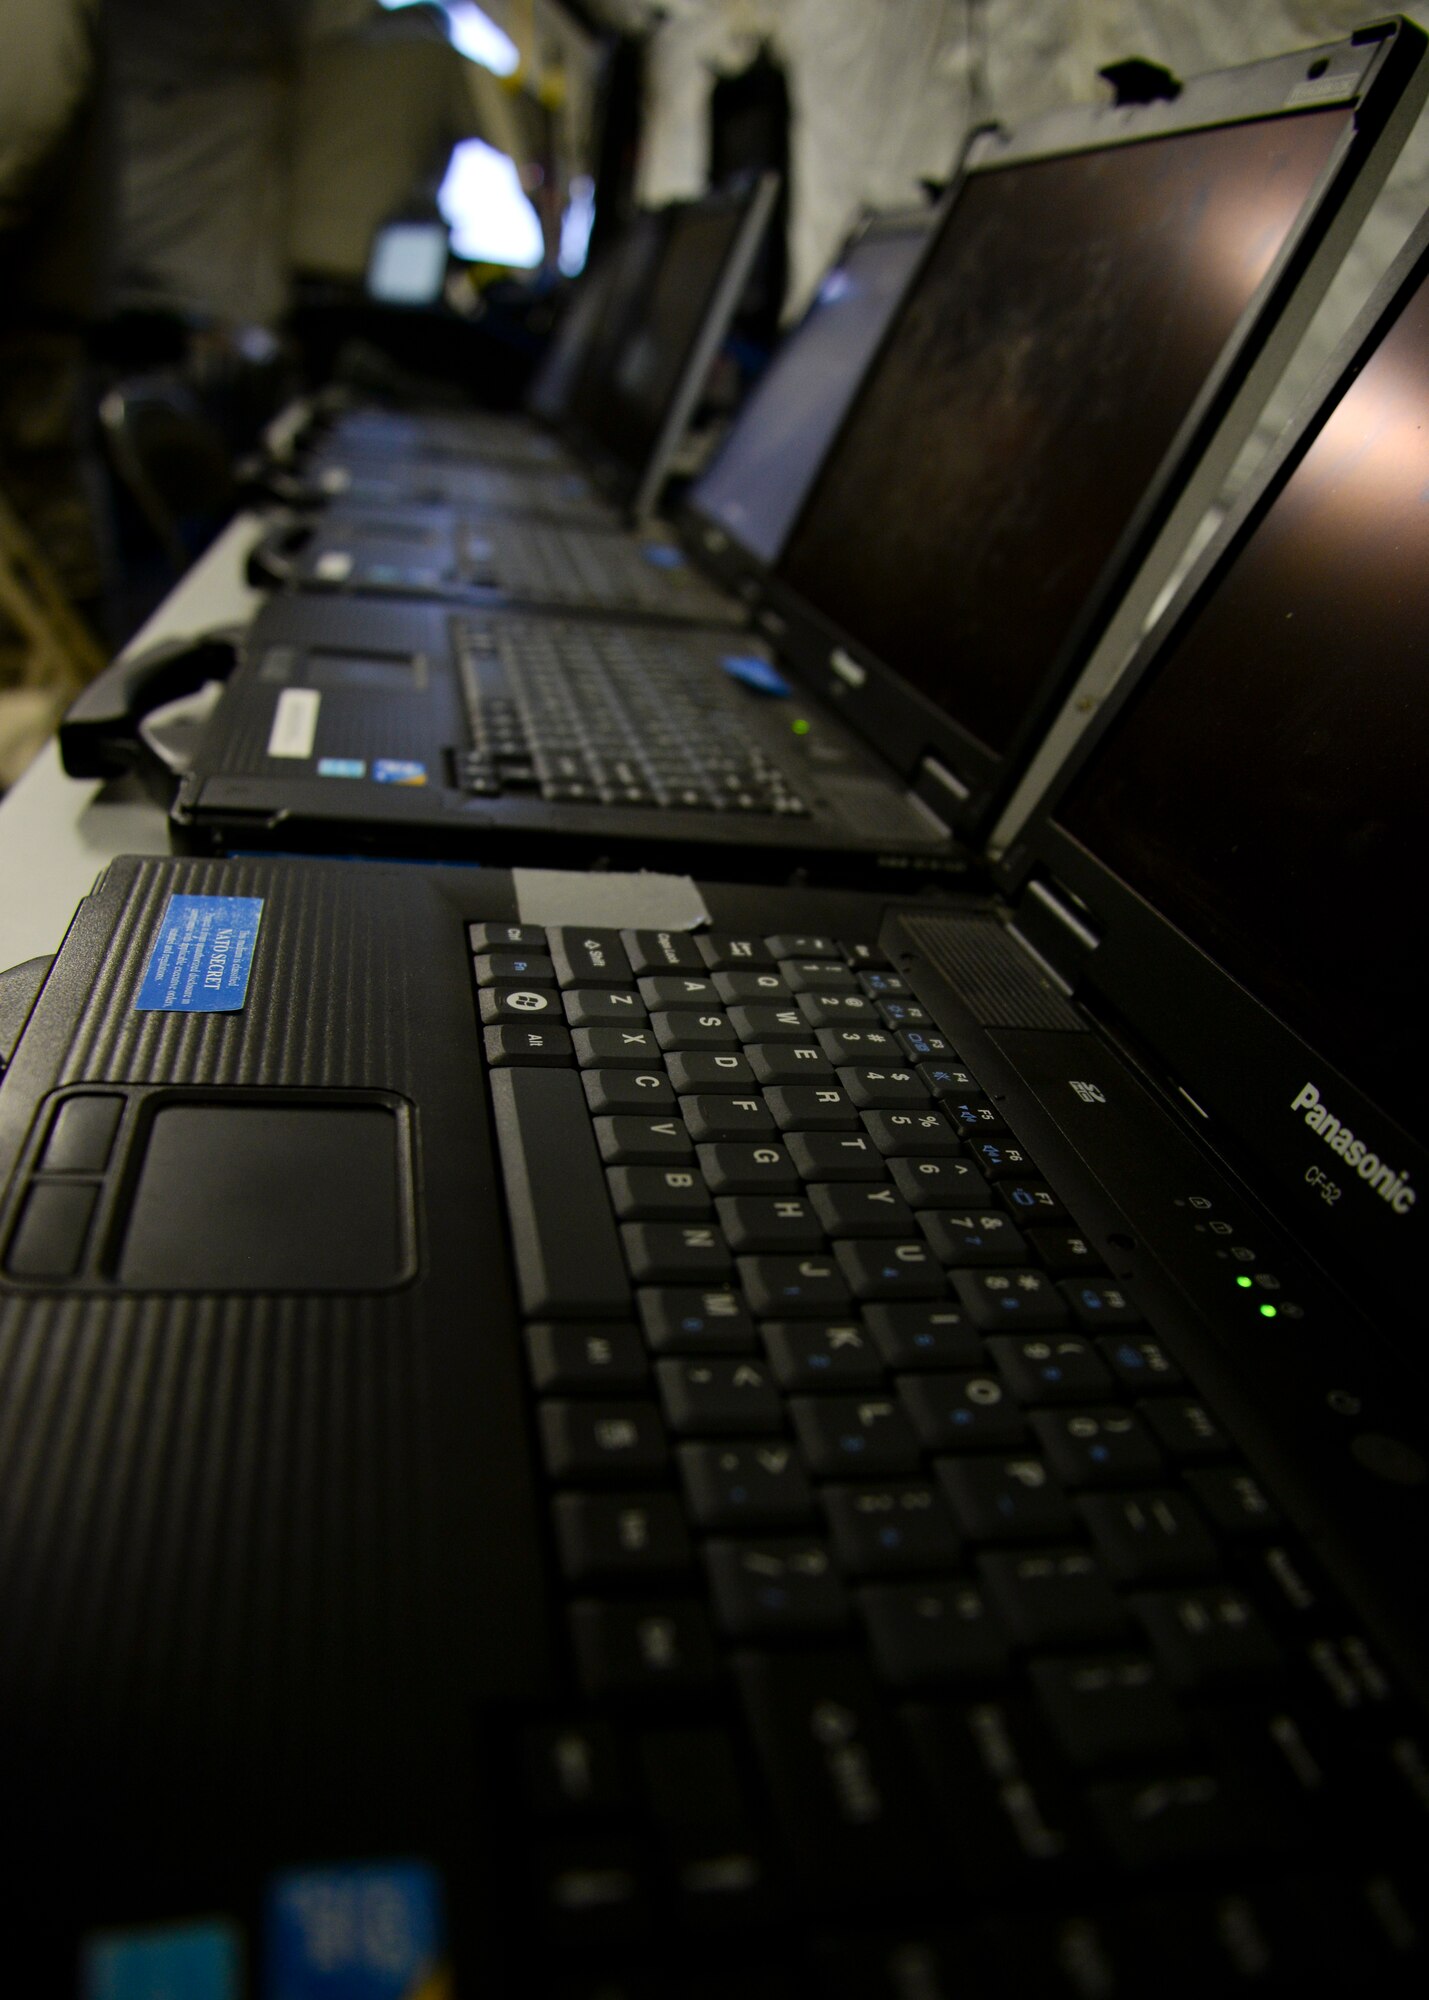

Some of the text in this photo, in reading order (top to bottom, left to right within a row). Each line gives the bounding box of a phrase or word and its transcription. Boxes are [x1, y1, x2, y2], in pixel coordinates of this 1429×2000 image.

[213, 928, 233, 951] NATO
[204, 953, 227, 990] SECRET
[683, 981, 706, 992] A
[757, 976, 779, 987] Q
[609, 994, 633, 1005] Z
[820, 997, 839, 1006] 2
[699, 1016, 722, 1027] S
[775, 1011, 800, 1025] W
[527, 1033, 544, 1047] Alt
[621, 1033, 647, 1045] X
[842, 1032, 861, 1041] 3
[929, 1038, 945, 1049] F3
[713, 1055, 739, 1068] D
[794, 1049, 818, 1060] E
[634, 1074, 660, 1088] C
[866, 1071, 886, 1081] 4
[952, 1071, 969, 1084] F4
[815, 1091, 841, 1103] R
[732, 1100, 759, 1112] F
[891, 1115, 912, 1125] 5
[977, 1108, 995, 1121] F5
[650, 1122, 677, 1136] V
[841, 1138, 867, 1152] T
[1290, 1081, 1417, 1215] Panasonic
[752, 1148, 780, 1164] G
[1005, 1149, 1023, 1162] F6
[918, 1163, 941, 1175] 6
[665, 1172, 694, 1188] B
[1304, 1165, 1343, 1207] CF-52
[867, 1189, 895, 1204] Y
[1034, 1191, 1054, 1206] F7
[773, 1202, 805, 1218] H
[950, 1216, 975, 1229] 7
[682, 1229, 716, 1248] N
[895, 1244, 927, 1262] U
[798, 1261, 832, 1277] J
[703, 1292, 740, 1317] M
[825, 1326, 863, 1349] K
[857, 1402, 894, 1427] L
